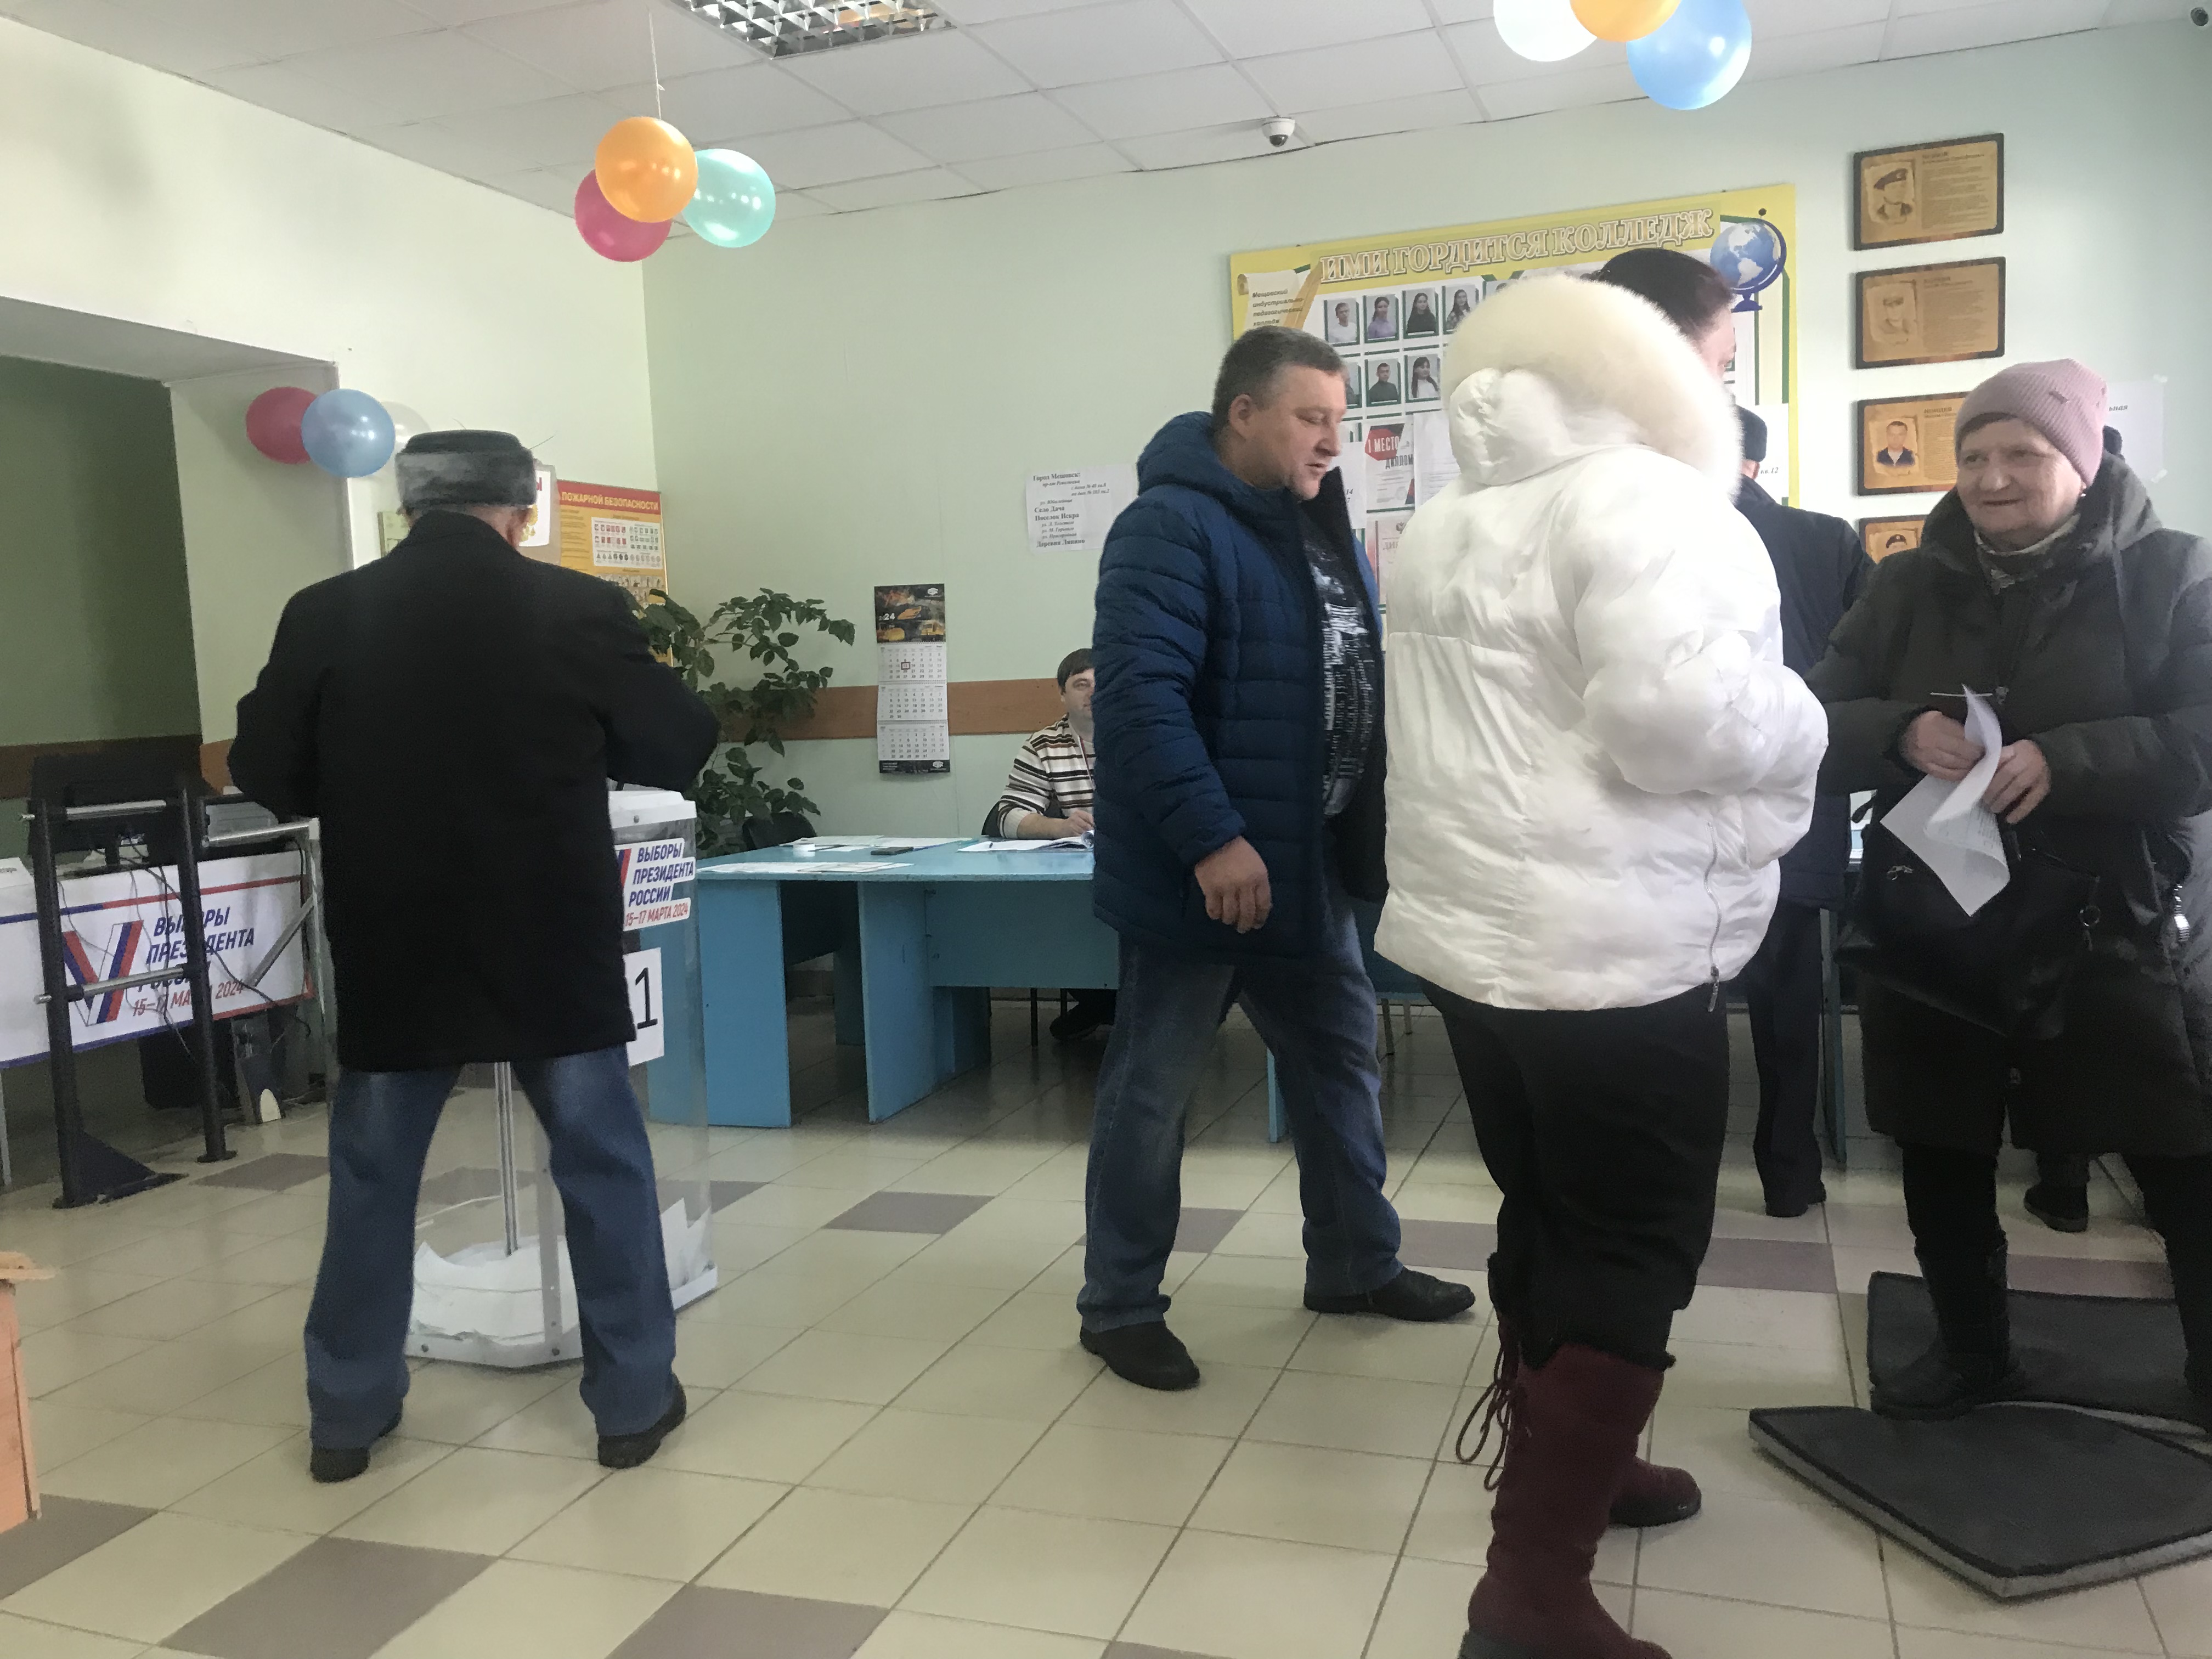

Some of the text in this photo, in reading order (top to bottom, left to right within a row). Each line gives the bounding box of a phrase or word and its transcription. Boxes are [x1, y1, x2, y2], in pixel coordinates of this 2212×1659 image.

[1320, 208, 1715, 284] ИМИ ГОРДИТСЯ КОЛЛЕДЖ
[1252, 289, 1288, 297] Мещовский
[1374, 436, 1400, 452] МЕСТО
[1385, 454, 1413, 469] ДИПЛОМ
[561, 492, 658, 511] ПОЖАРНОЙ БЕЗОПАСНОСТИ
[636, 842, 682, 863] ВЫБОРЫ
[633, 861, 693, 885] ПРЕЗИДЕНТА
[628, 885, 671, 907] РОССИИ
[154, 907, 230, 936] ВЫРЫ
[647, 906, 672, 923] МАРТА
[673, 902, 689, 918] 2024
[145, 928, 255, 965] ПРЕЗДЕНТА
[635, 967, 658, 1030] 1
